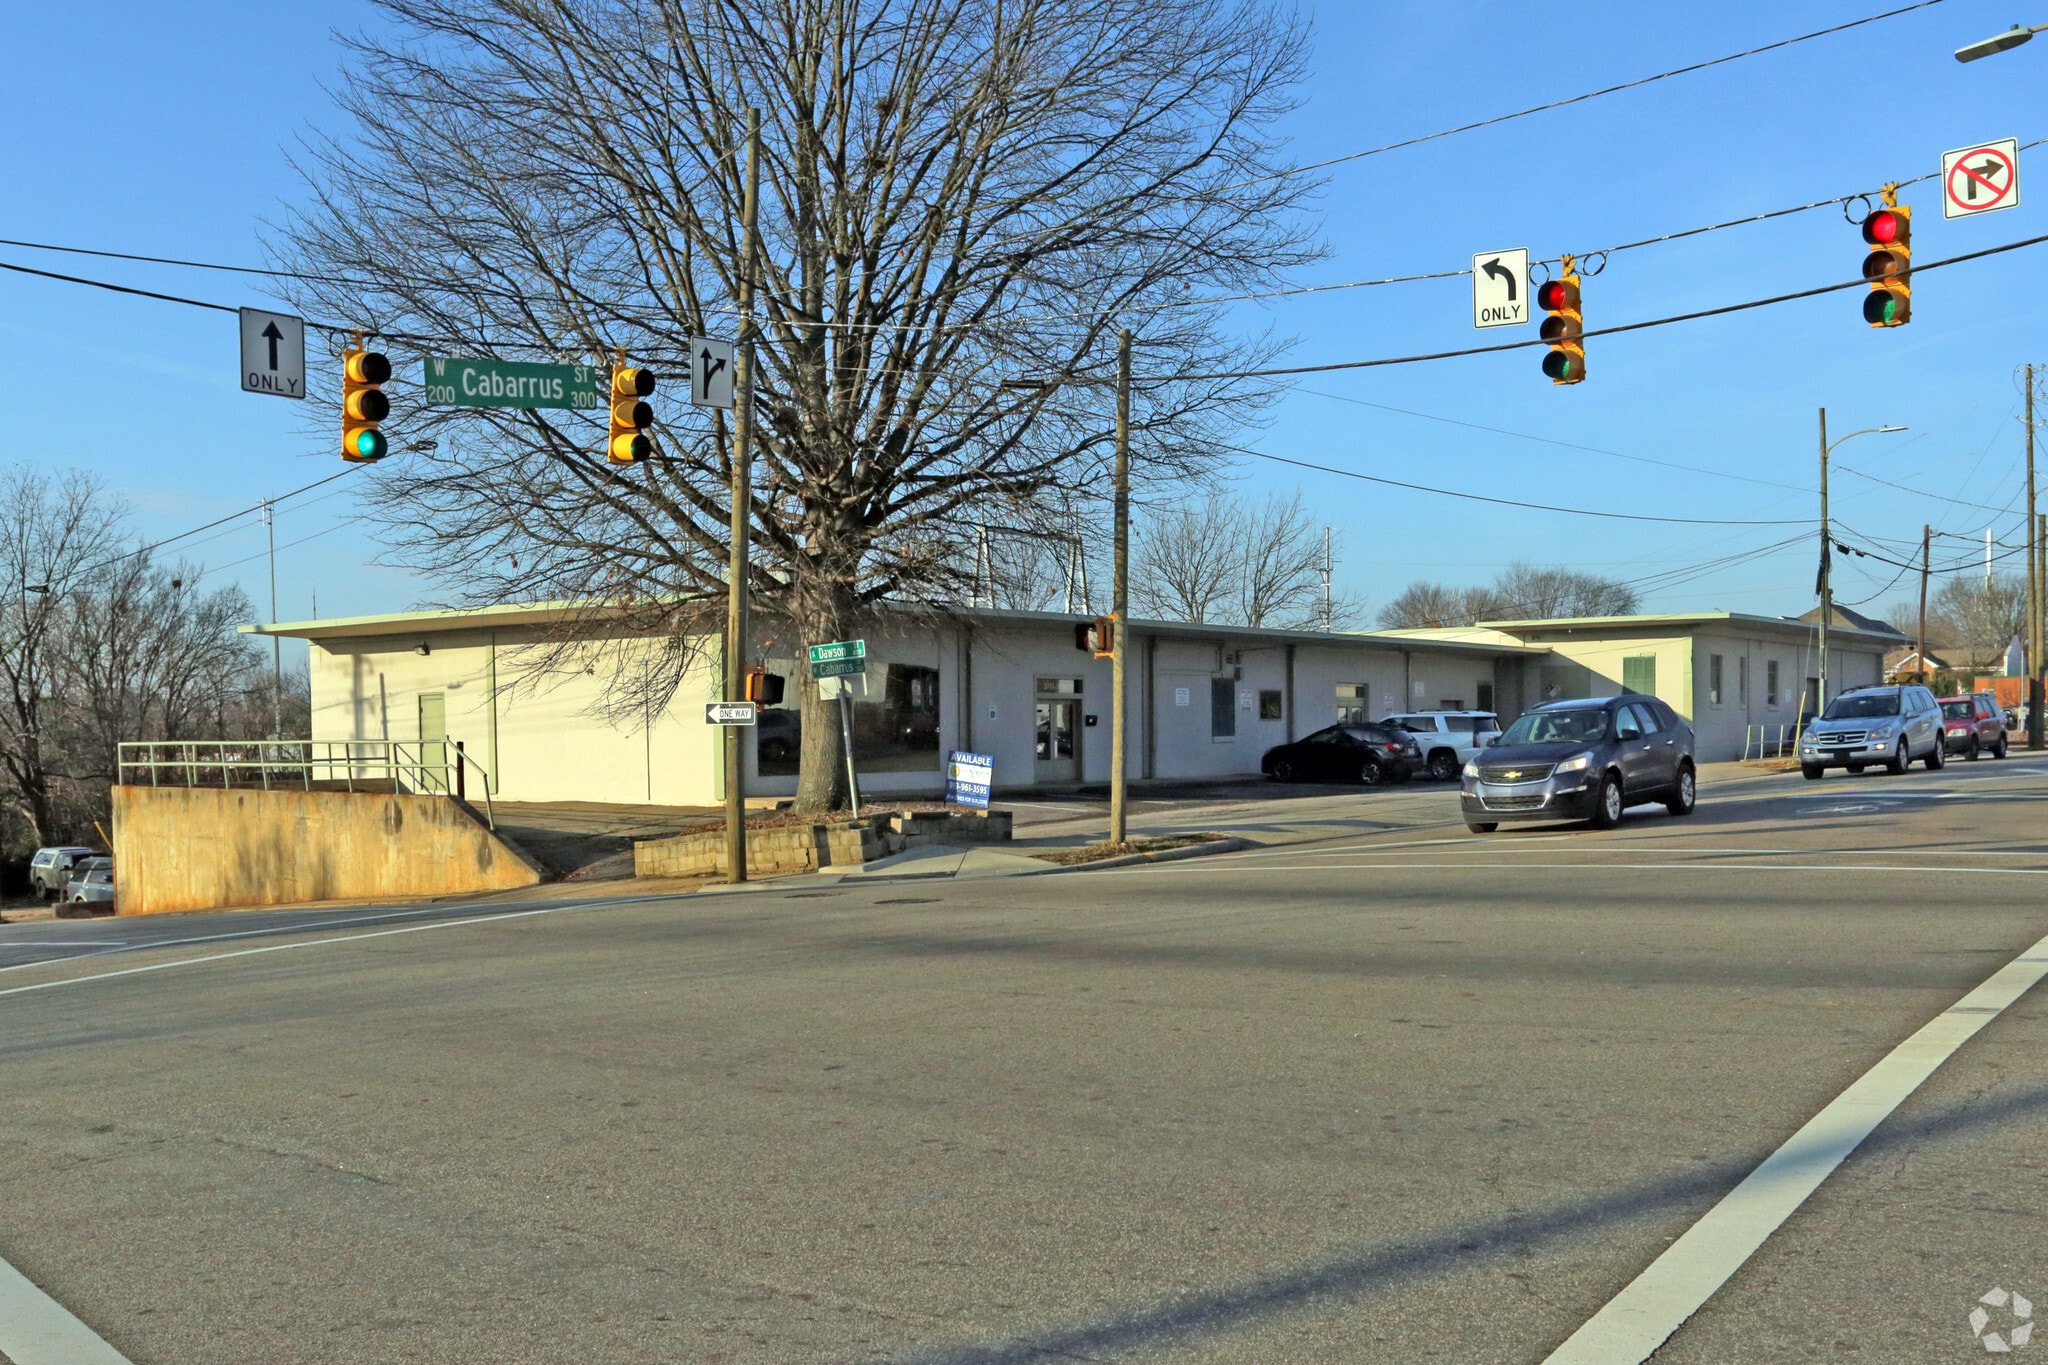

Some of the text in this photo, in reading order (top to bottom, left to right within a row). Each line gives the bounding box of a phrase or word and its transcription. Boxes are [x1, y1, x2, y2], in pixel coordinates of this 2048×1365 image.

[1481, 304, 1521, 322] ONLY
[433, 358, 446, 377] W
[574, 366, 589, 383] ST
[248, 372, 298, 393] ONLY
[462, 367, 564, 400] Cabarrus
[427, 385, 456, 403] 200
[570, 391, 596, 408] 300
[818, 646, 847, 660] Dawson
[820, 662, 854, 676] Cabarrus
[720, 709, 749, 718] ONE WAY
[951, 752, 991, 766] AVAILABLE
